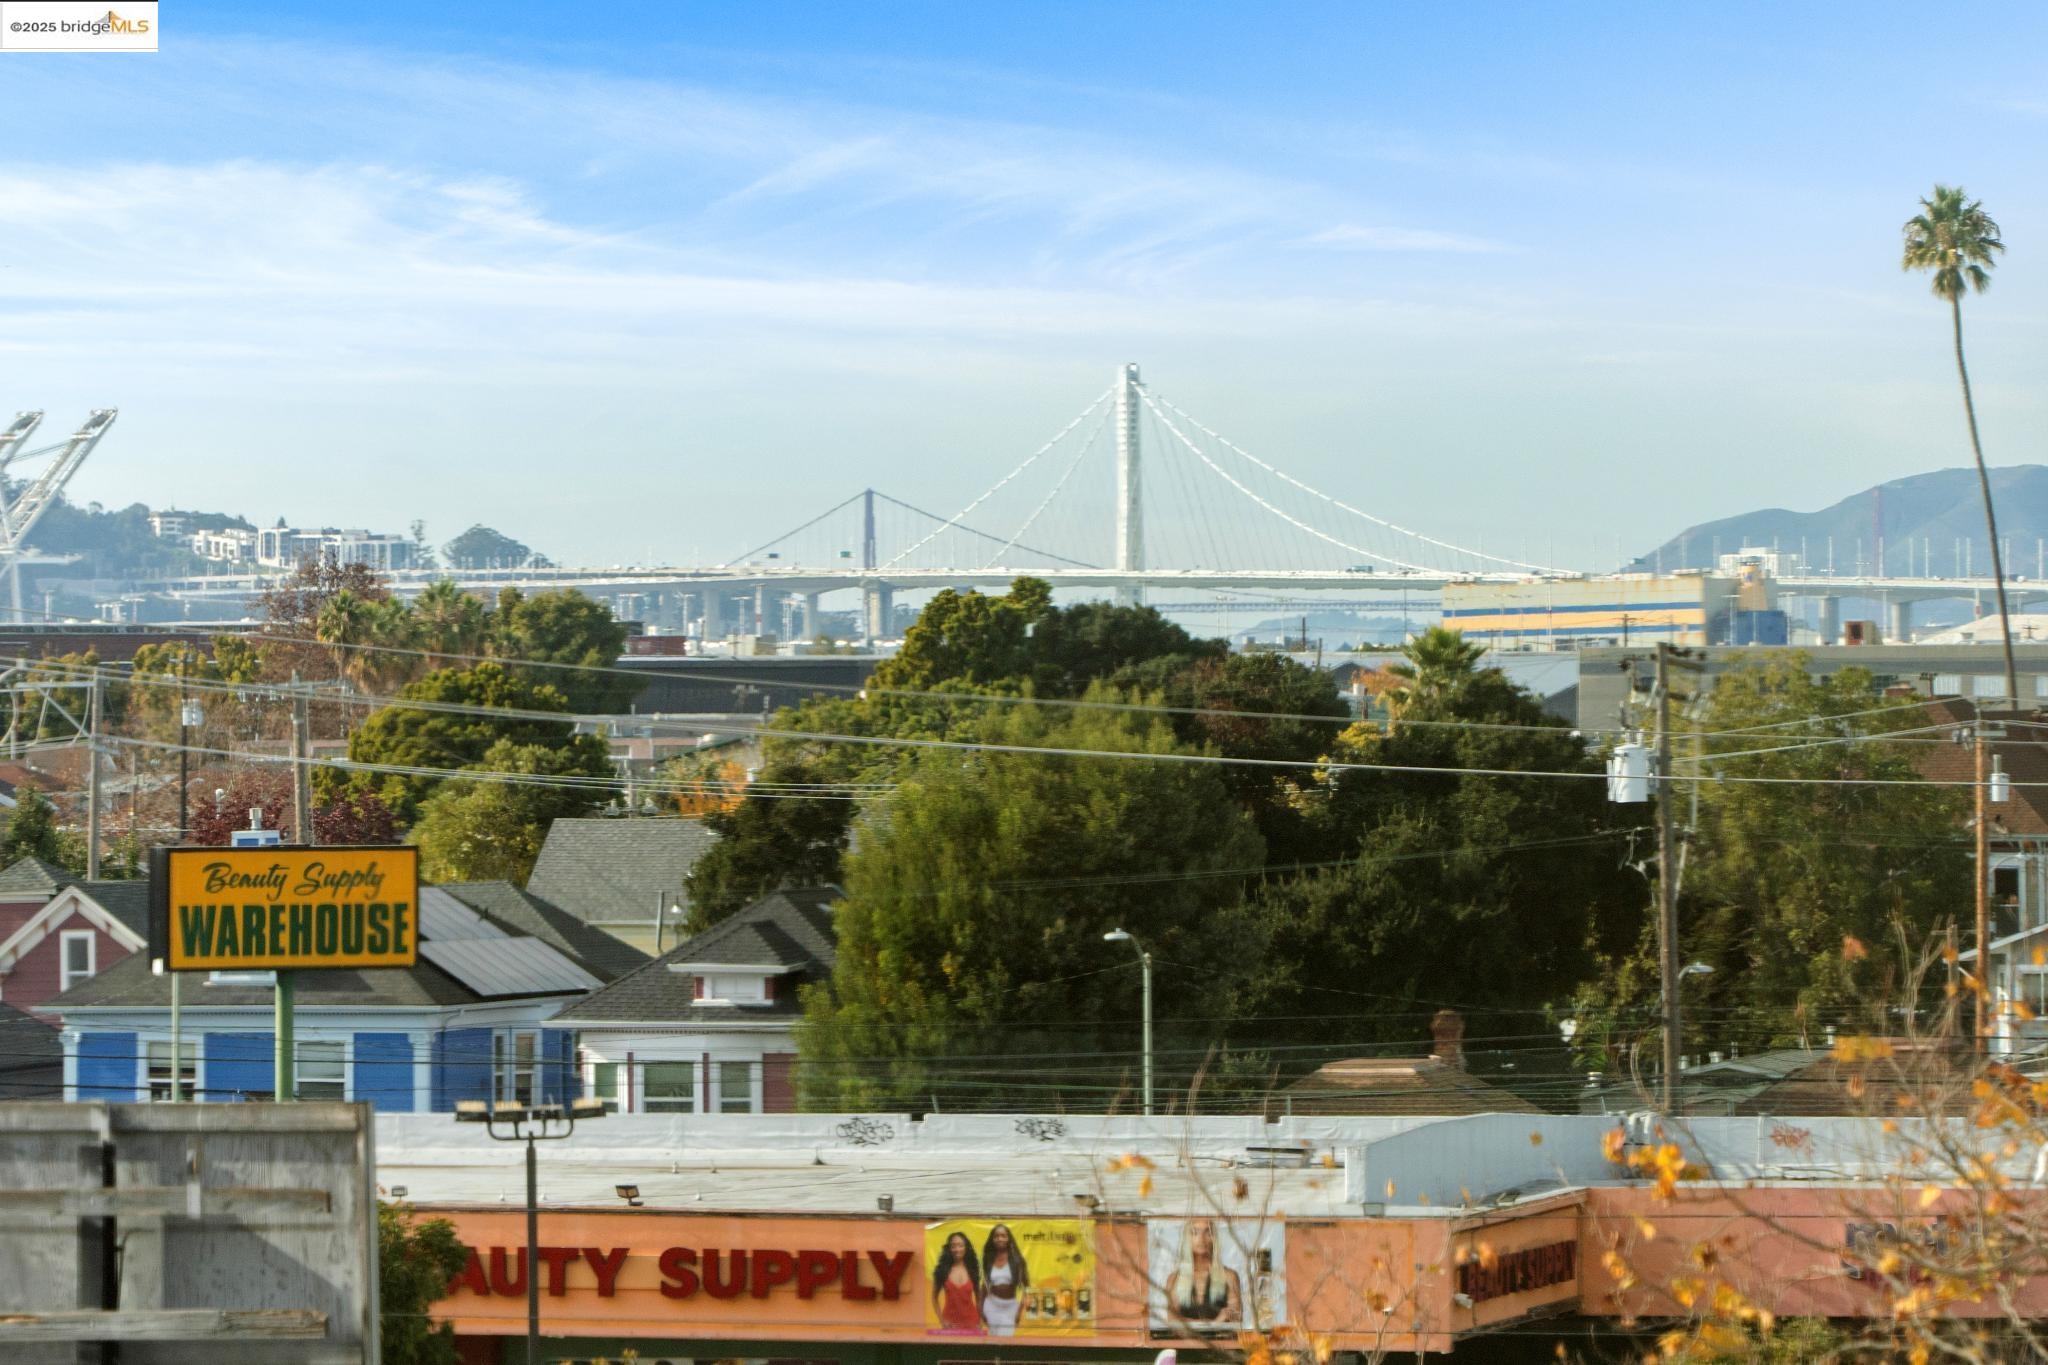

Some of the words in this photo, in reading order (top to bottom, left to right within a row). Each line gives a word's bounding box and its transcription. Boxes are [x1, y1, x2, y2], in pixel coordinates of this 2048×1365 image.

[202, 862, 290, 901] Beauty
[293, 861, 386, 899] Supply
[178, 903, 408, 957] WAREHOUSE
[448, 1246, 630, 1298] AUTY
[658, 1246, 915, 1300] SUPPLY
